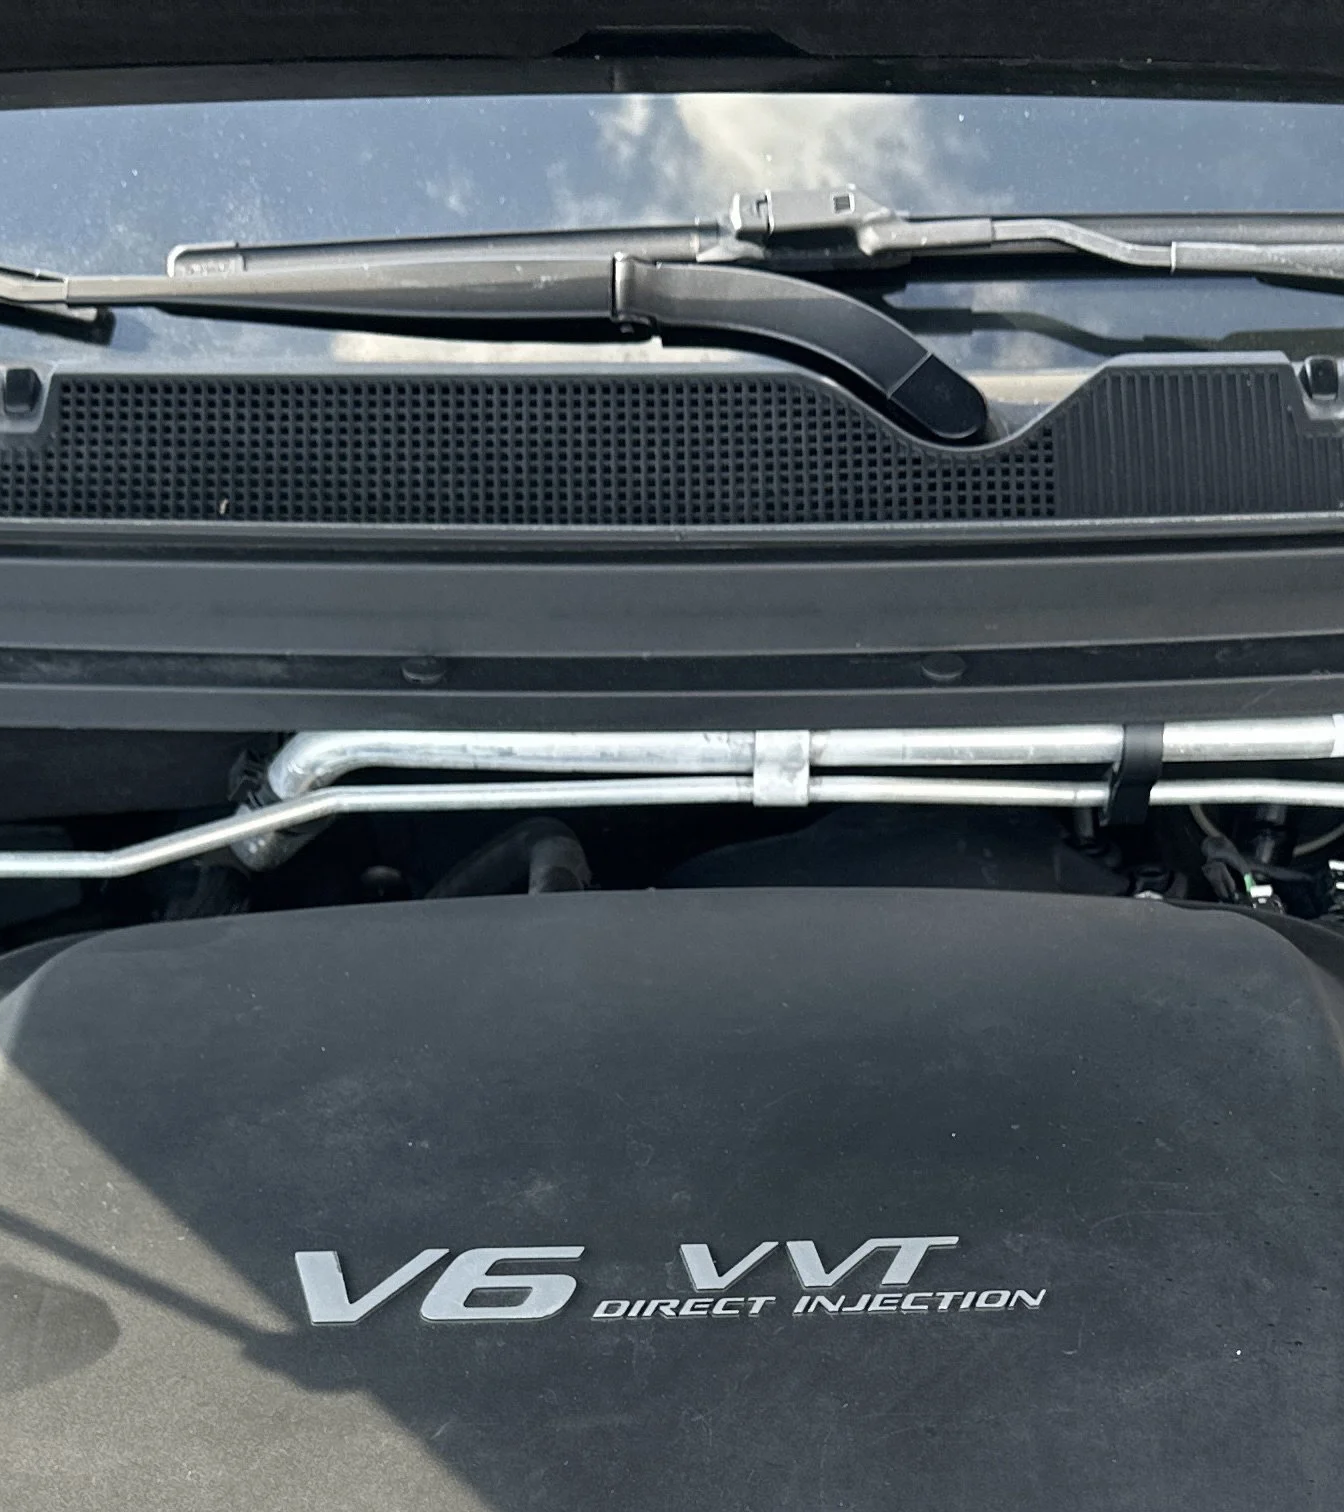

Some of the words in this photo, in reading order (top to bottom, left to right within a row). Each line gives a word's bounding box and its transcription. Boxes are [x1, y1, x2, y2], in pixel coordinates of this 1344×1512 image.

[294, 1245, 585, 1324] V6
[678, 1235, 959, 1291] VVT
[590, 1296, 778, 1321] DIRECT
[790, 1288, 1048, 1318] INJECTION
